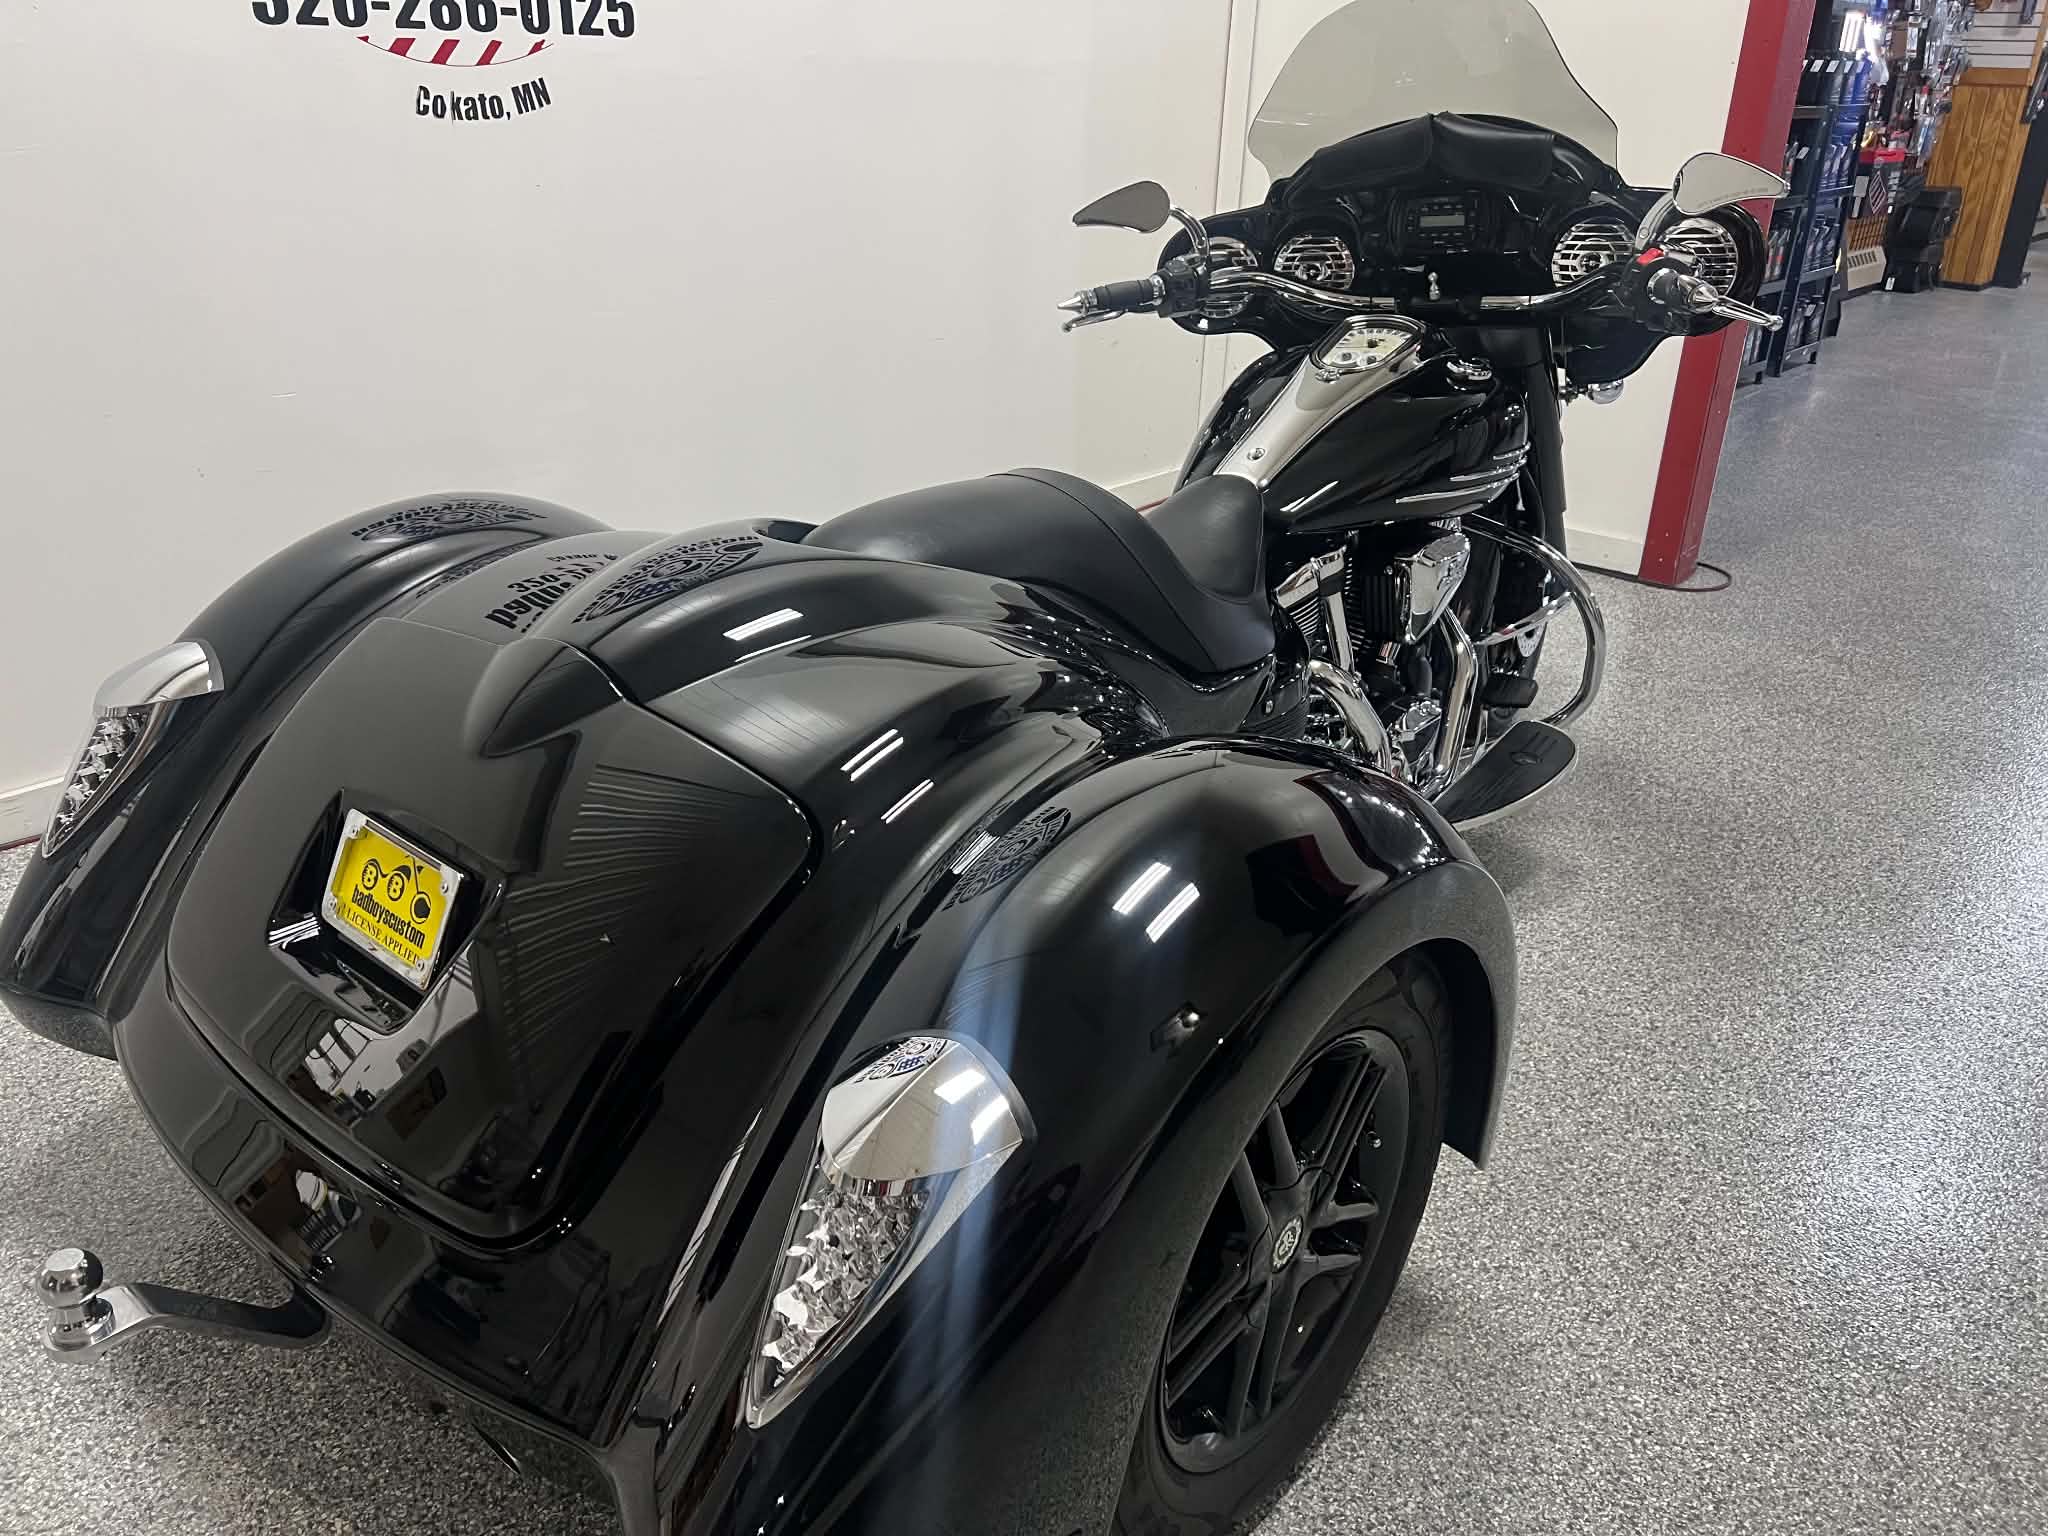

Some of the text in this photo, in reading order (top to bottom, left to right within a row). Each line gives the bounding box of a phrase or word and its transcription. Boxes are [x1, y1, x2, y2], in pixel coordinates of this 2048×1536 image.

[511, 77, 551, 115] MN
[345, 908, 384, 941] LICENSE
[351, 884, 426, 950] badboyscustom
